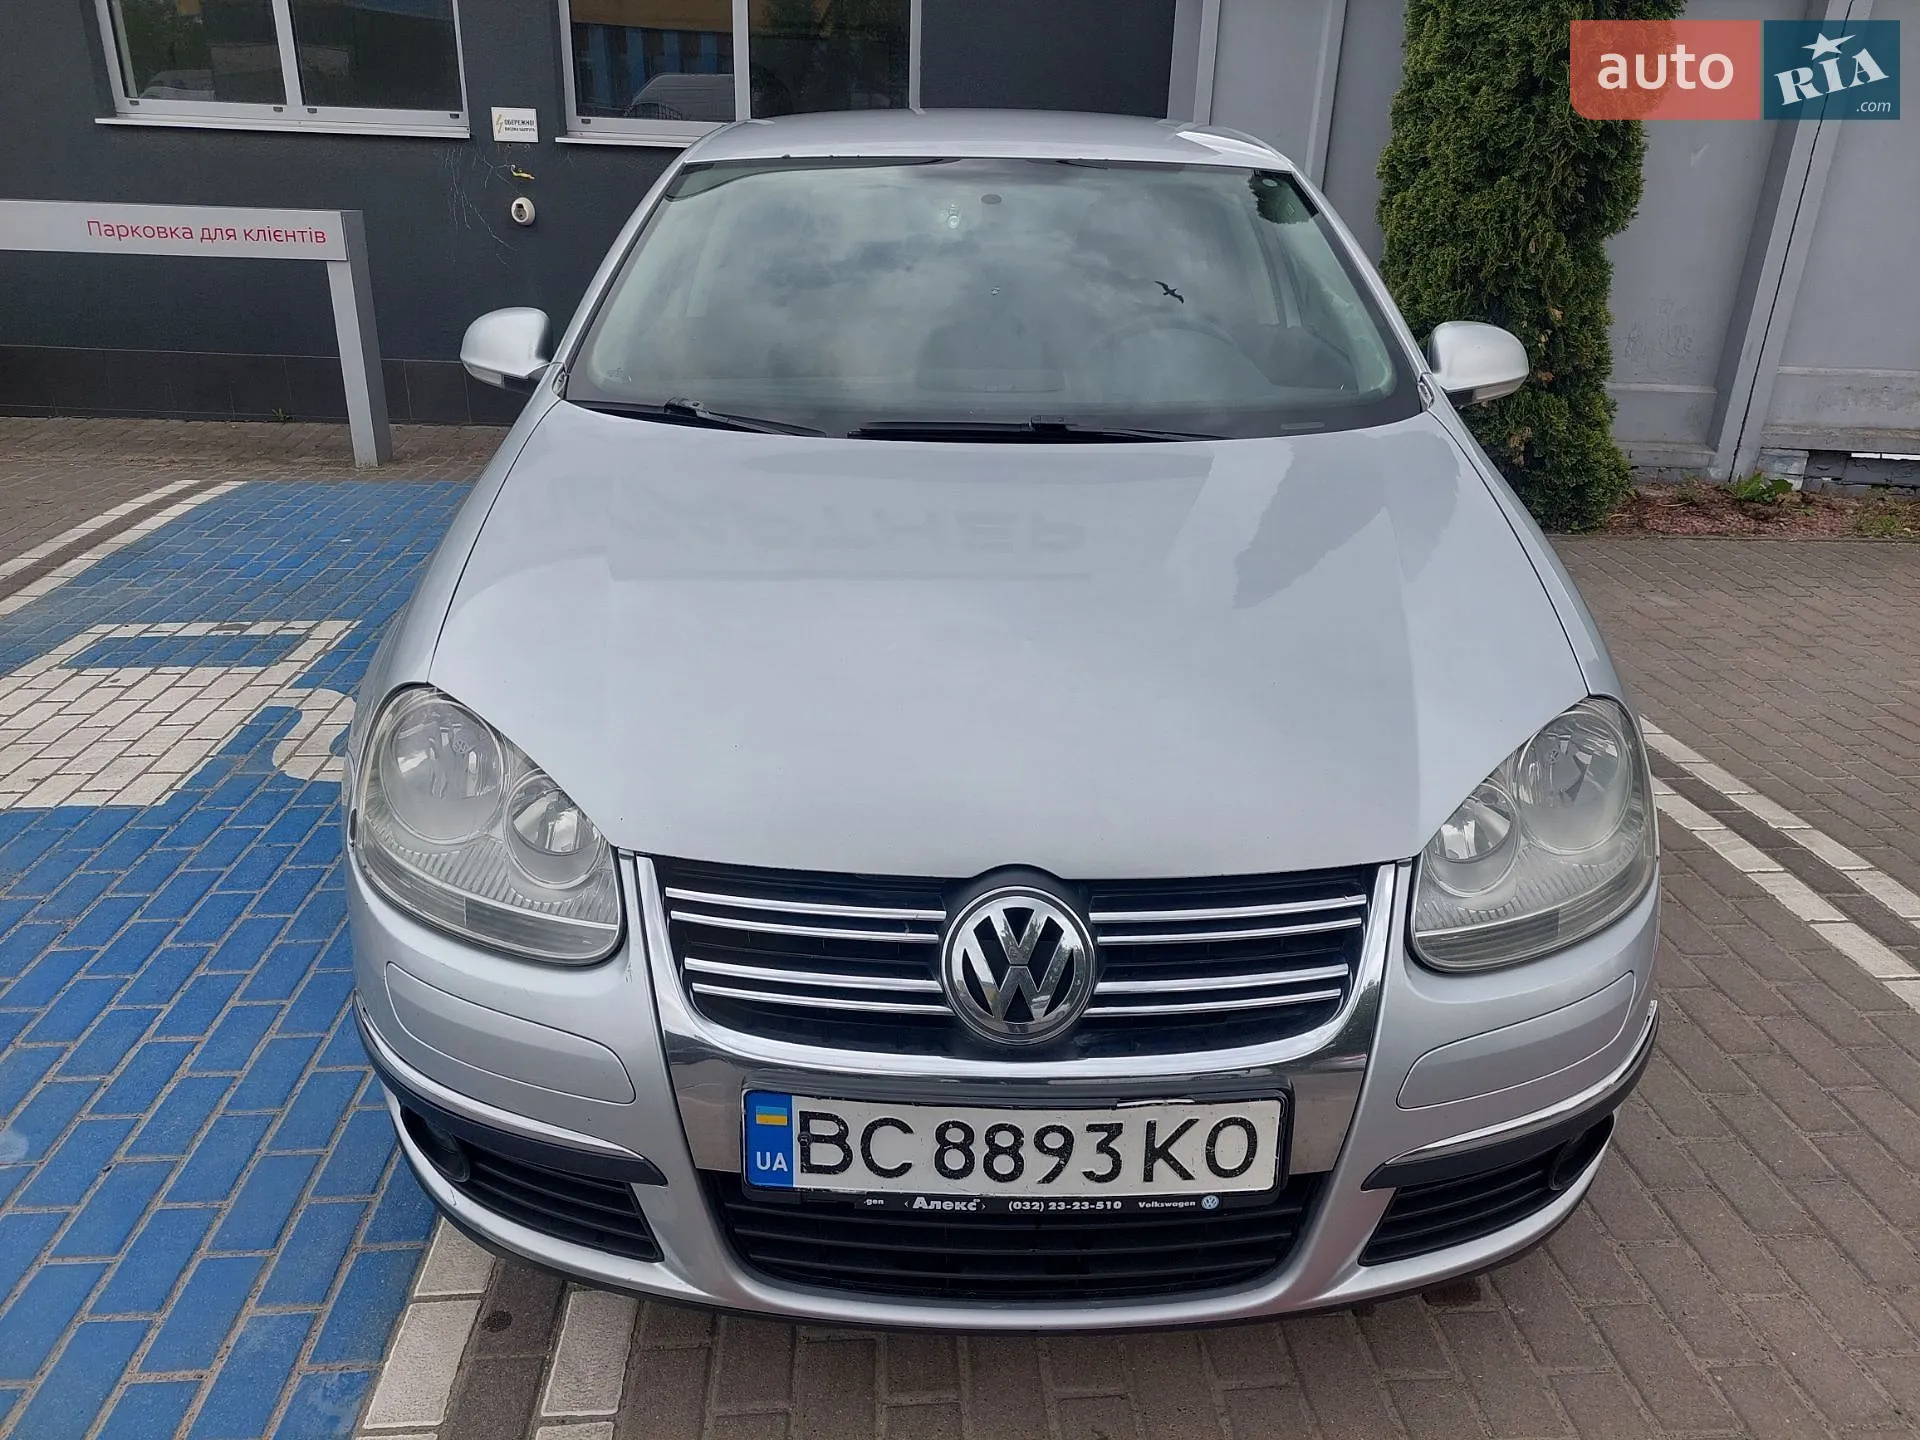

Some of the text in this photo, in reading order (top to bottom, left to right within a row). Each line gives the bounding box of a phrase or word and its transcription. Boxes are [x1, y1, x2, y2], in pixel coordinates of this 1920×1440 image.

[87, 220, 327, 245] Парковка для клієнтів
[755, 1152, 789, 1173] UA
[933, 1119, 1123, 1185] 8893
[1008, 1200, 1122, 1211] (032) 23-23-510
[1138, 1200, 1196, 1209] Volkswagen
